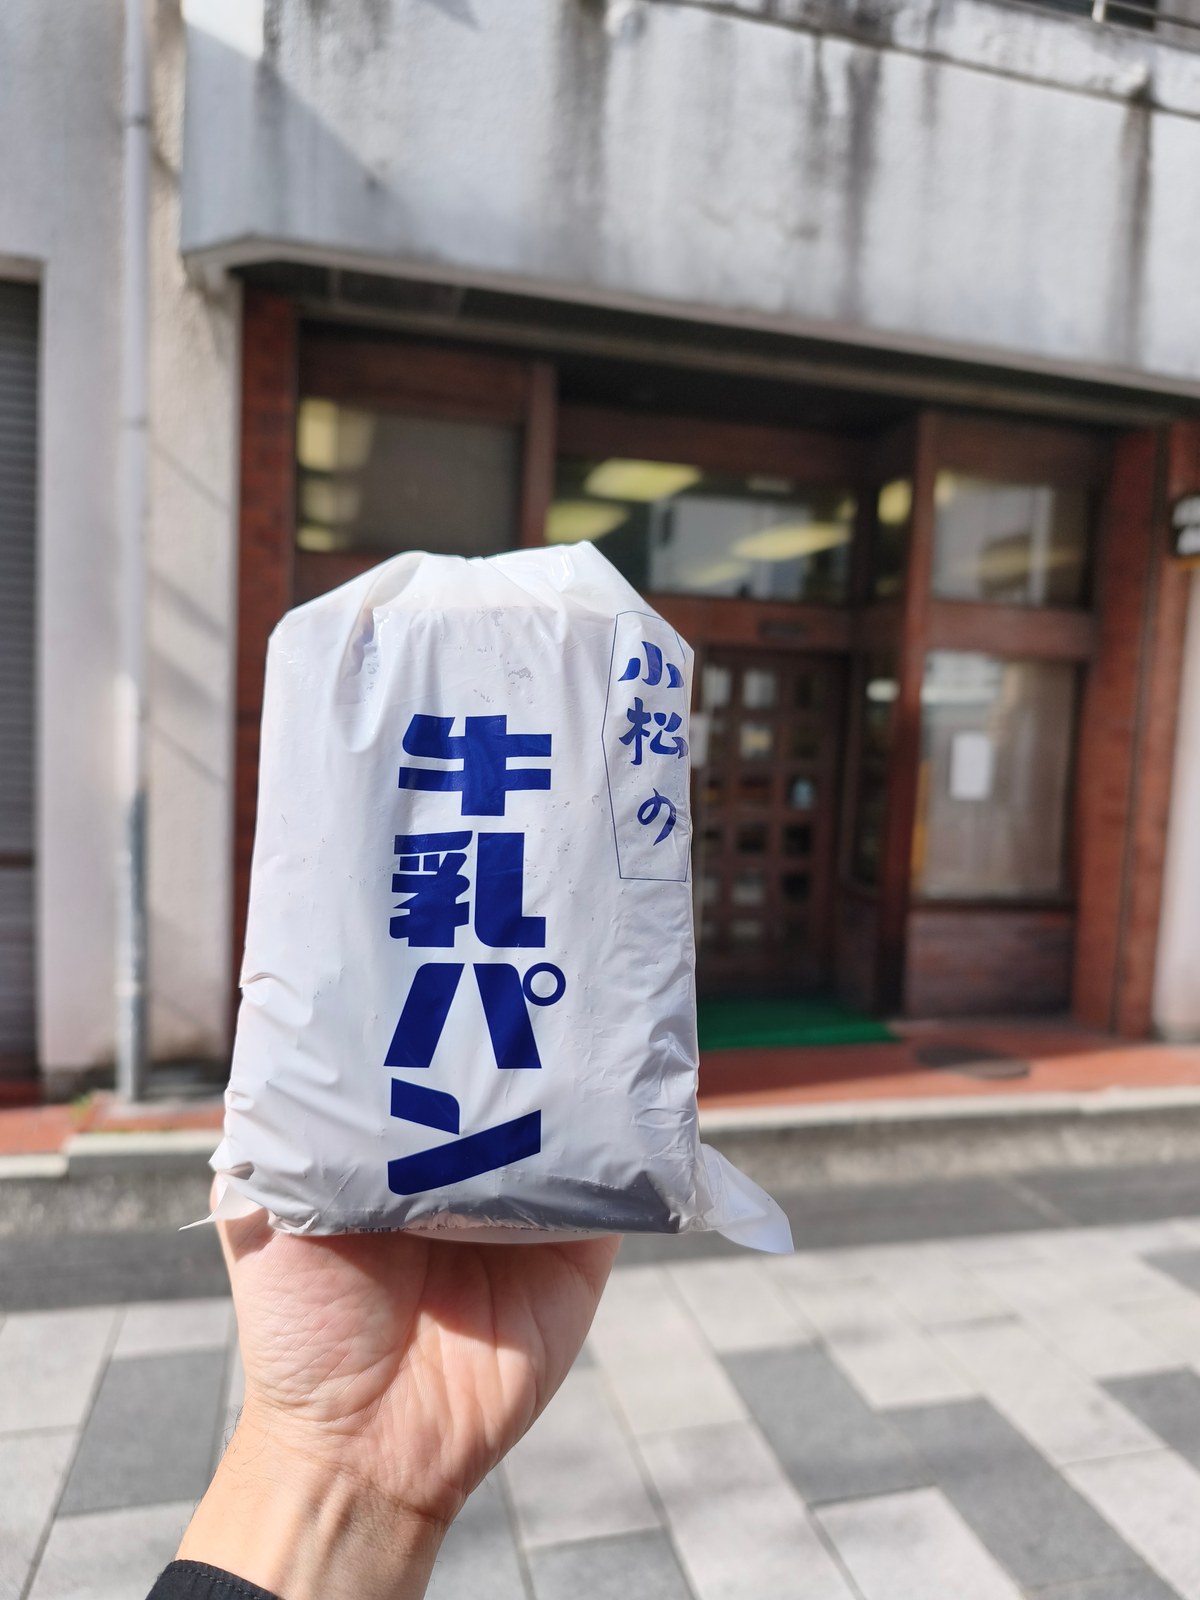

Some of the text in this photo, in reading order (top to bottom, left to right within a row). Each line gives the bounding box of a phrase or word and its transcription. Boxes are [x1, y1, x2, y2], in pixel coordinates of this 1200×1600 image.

[618, 641, 688, 846] 小松の
[383, 713, 567, 1196] 牛乳パン
